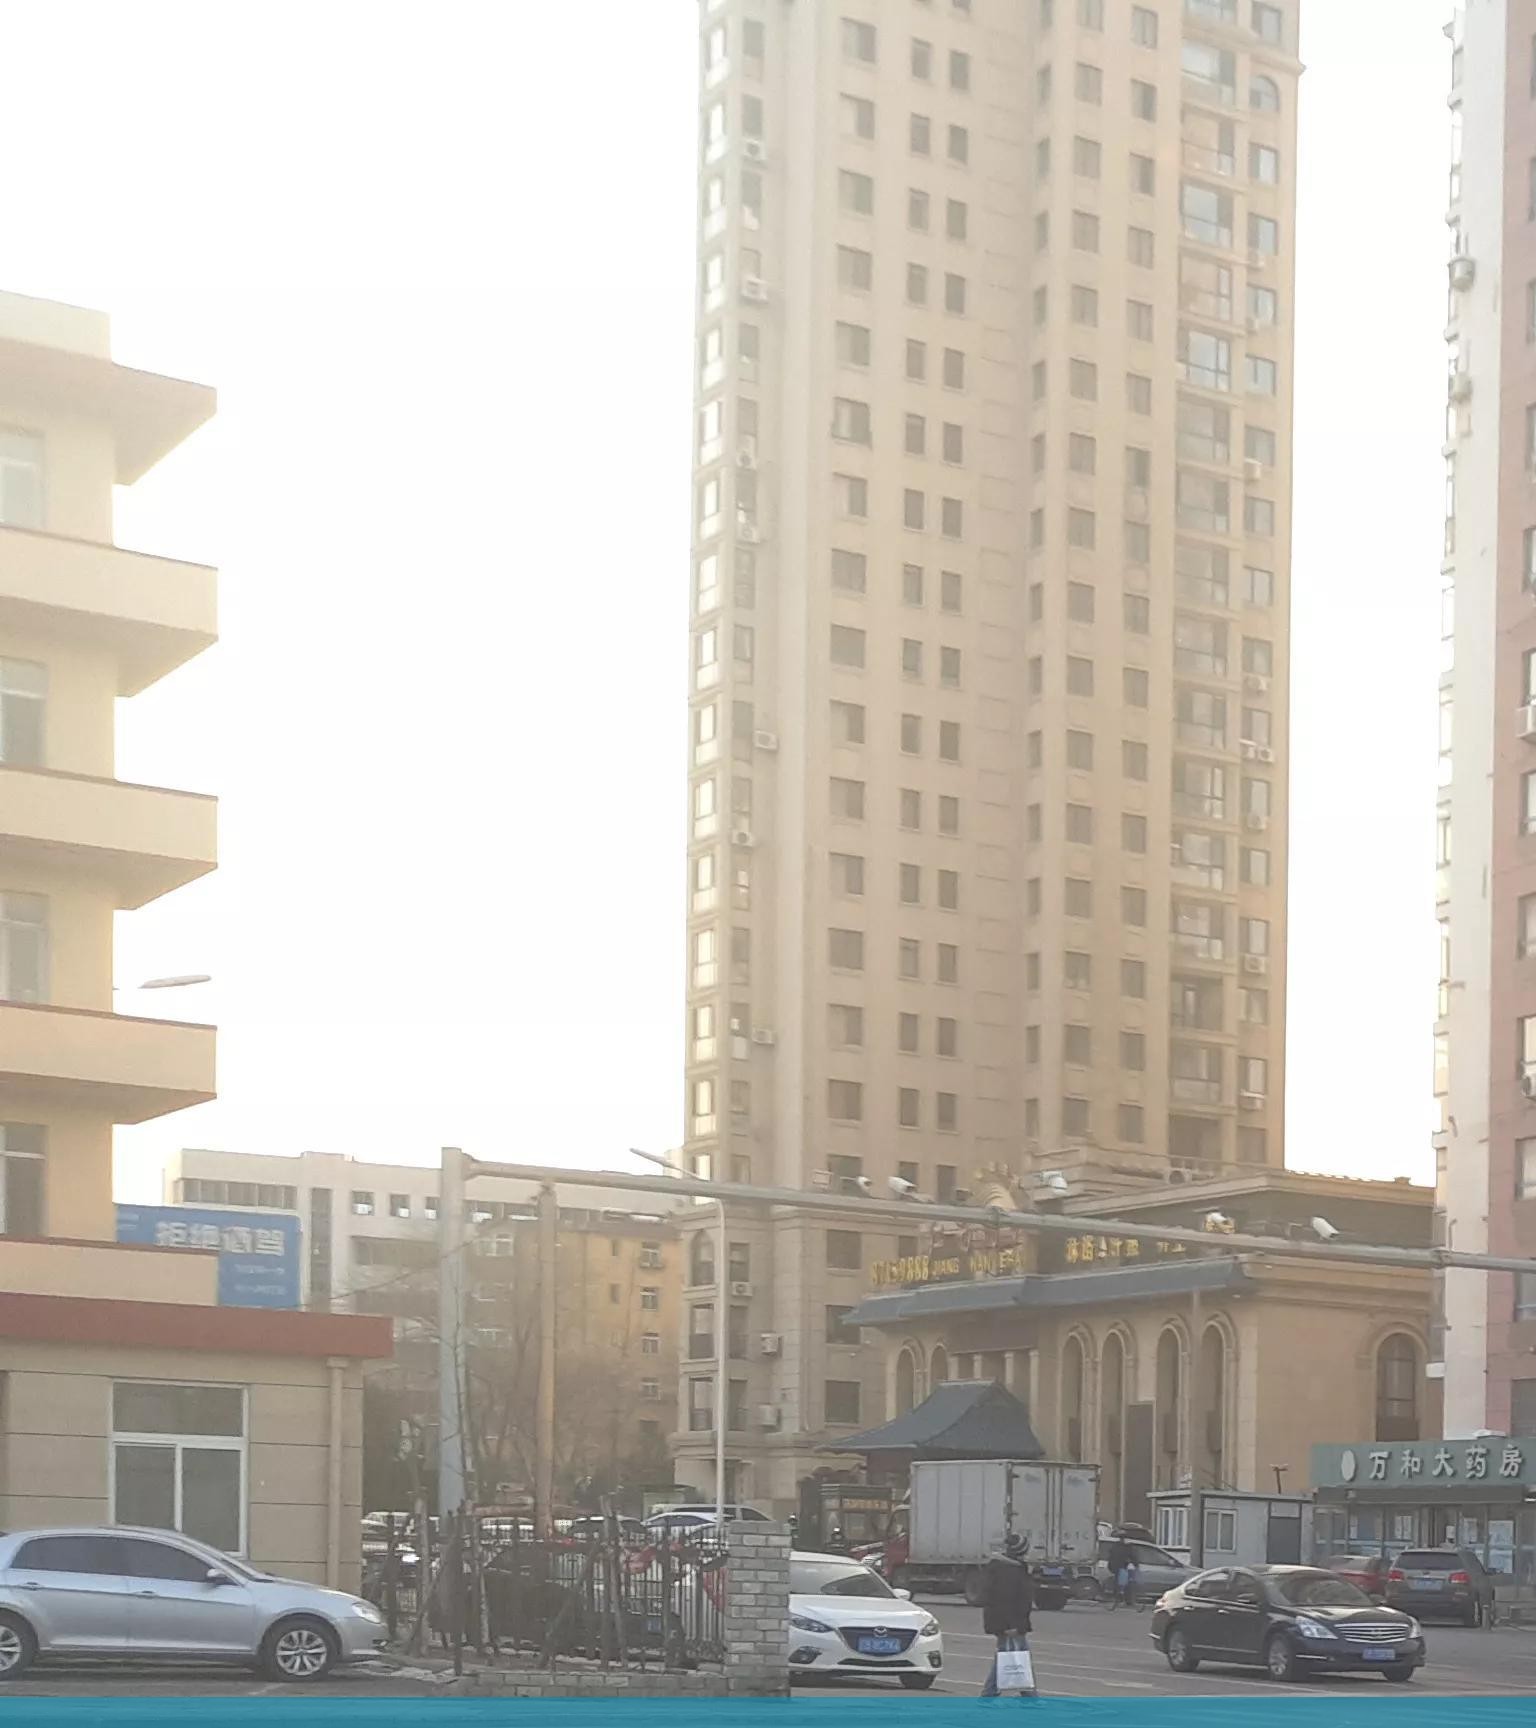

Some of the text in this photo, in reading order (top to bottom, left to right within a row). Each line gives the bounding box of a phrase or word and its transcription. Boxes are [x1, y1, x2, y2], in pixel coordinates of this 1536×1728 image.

[1368, 1443, 1525, 1480] 万和大药房
